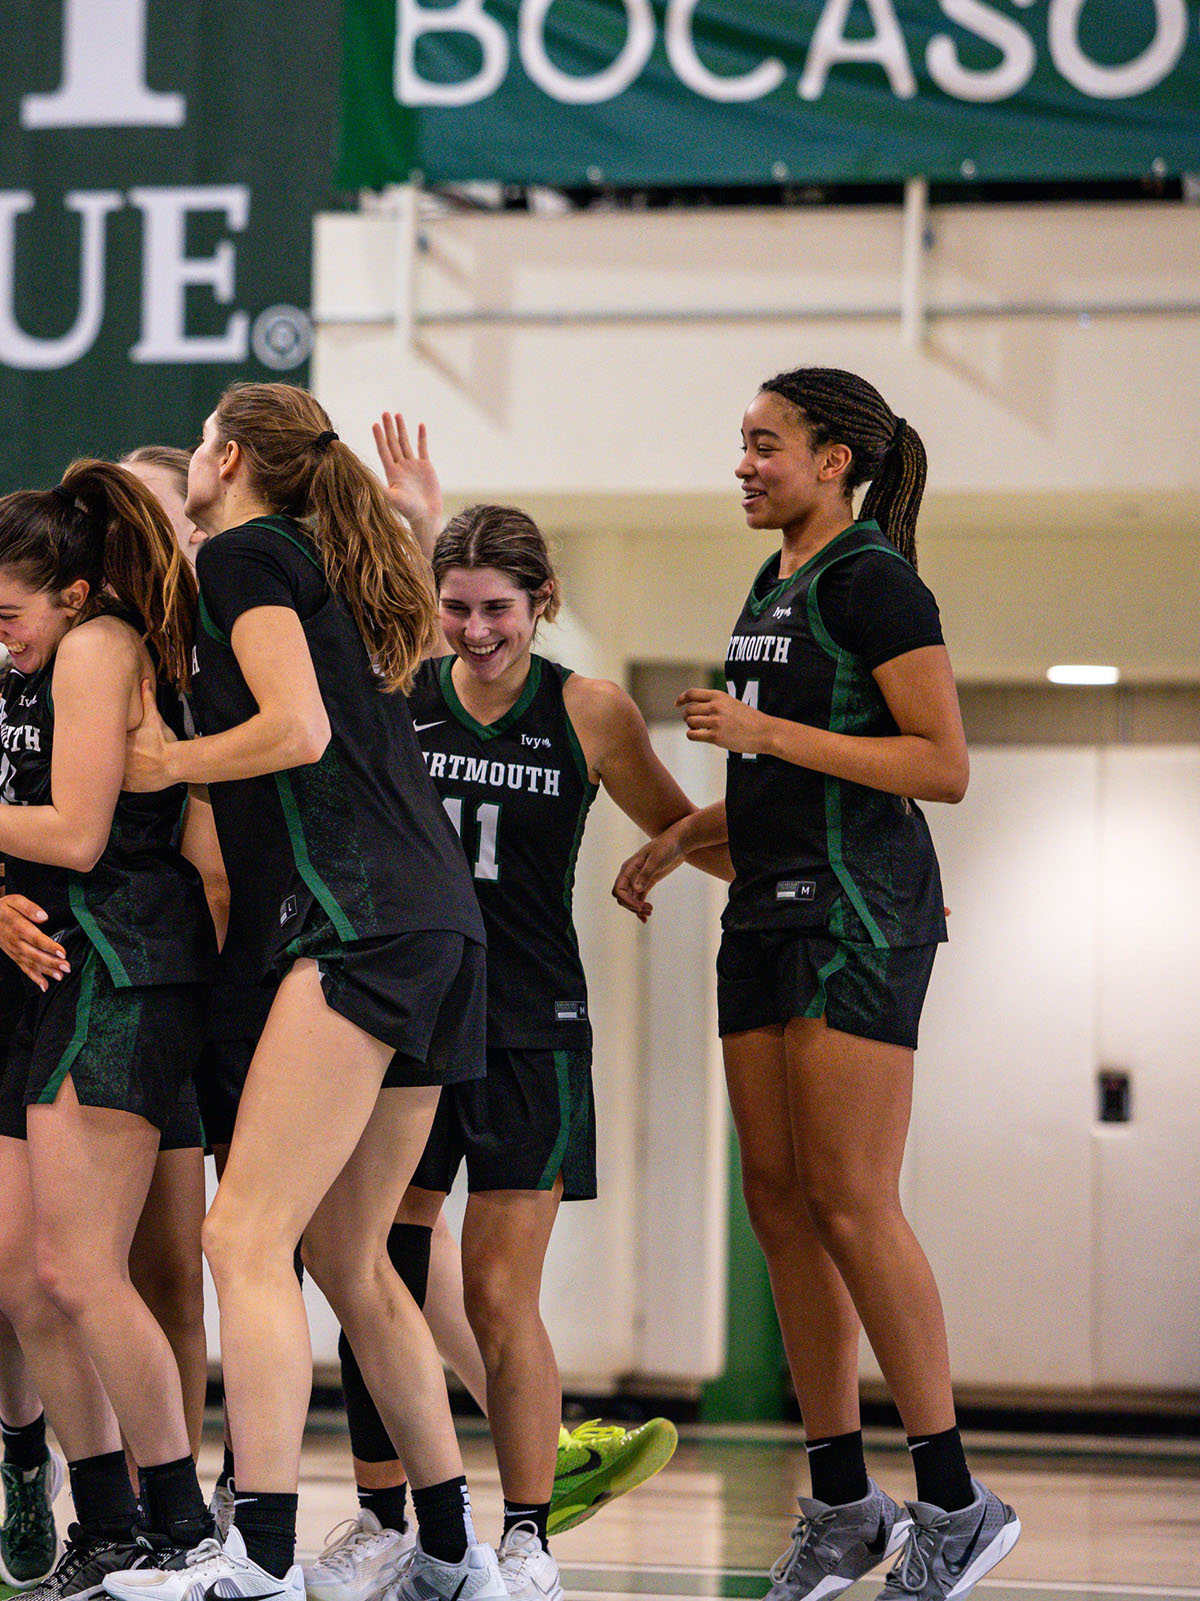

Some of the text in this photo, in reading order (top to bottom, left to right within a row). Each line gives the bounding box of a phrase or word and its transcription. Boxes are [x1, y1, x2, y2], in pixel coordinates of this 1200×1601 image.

[725, 635, 792, 664] TMOUTH
[521, 733, 542, 749] Ivy
[422, 751, 561, 796] RTMOUTH
